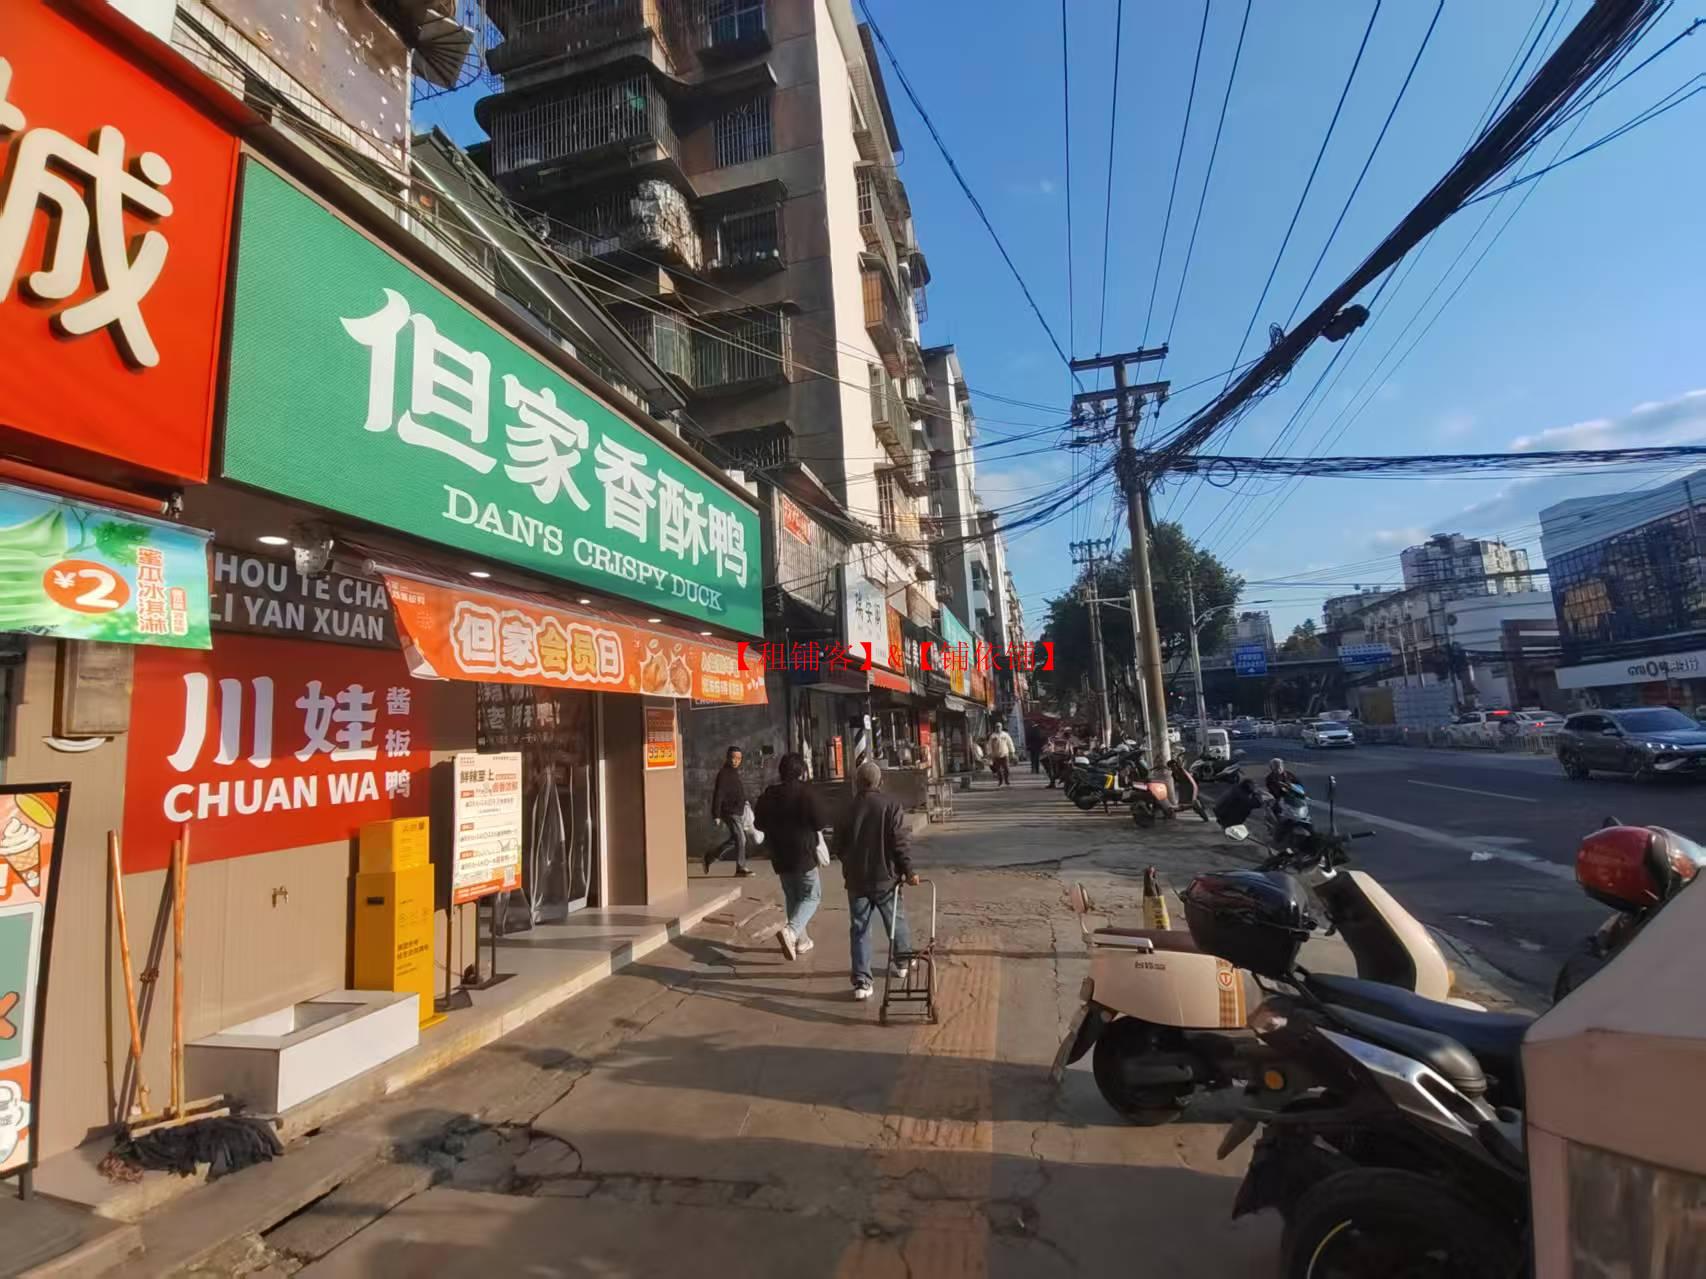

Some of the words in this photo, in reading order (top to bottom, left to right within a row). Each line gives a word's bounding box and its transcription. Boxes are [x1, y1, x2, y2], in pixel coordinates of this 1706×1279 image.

[340, 288, 748, 586] 但家香酥鸭
[442, 484, 564, 557] DAN'S
[573, 538, 672, 591] CRISPY
[671, 572, 722, 612] DUCK
[244, 596, 305, 631] YAN
[313, 607, 384, 641] XUAN
[338, 578, 389, 610] CHA
[457, 611, 622, 680] 但家会员日
[167, 672, 379, 772] 川娃
[385, 686, 412, 799] 酱板鸭
[163, 773, 318, 823] CHUAN
[328, 770, 380, 802] WA
